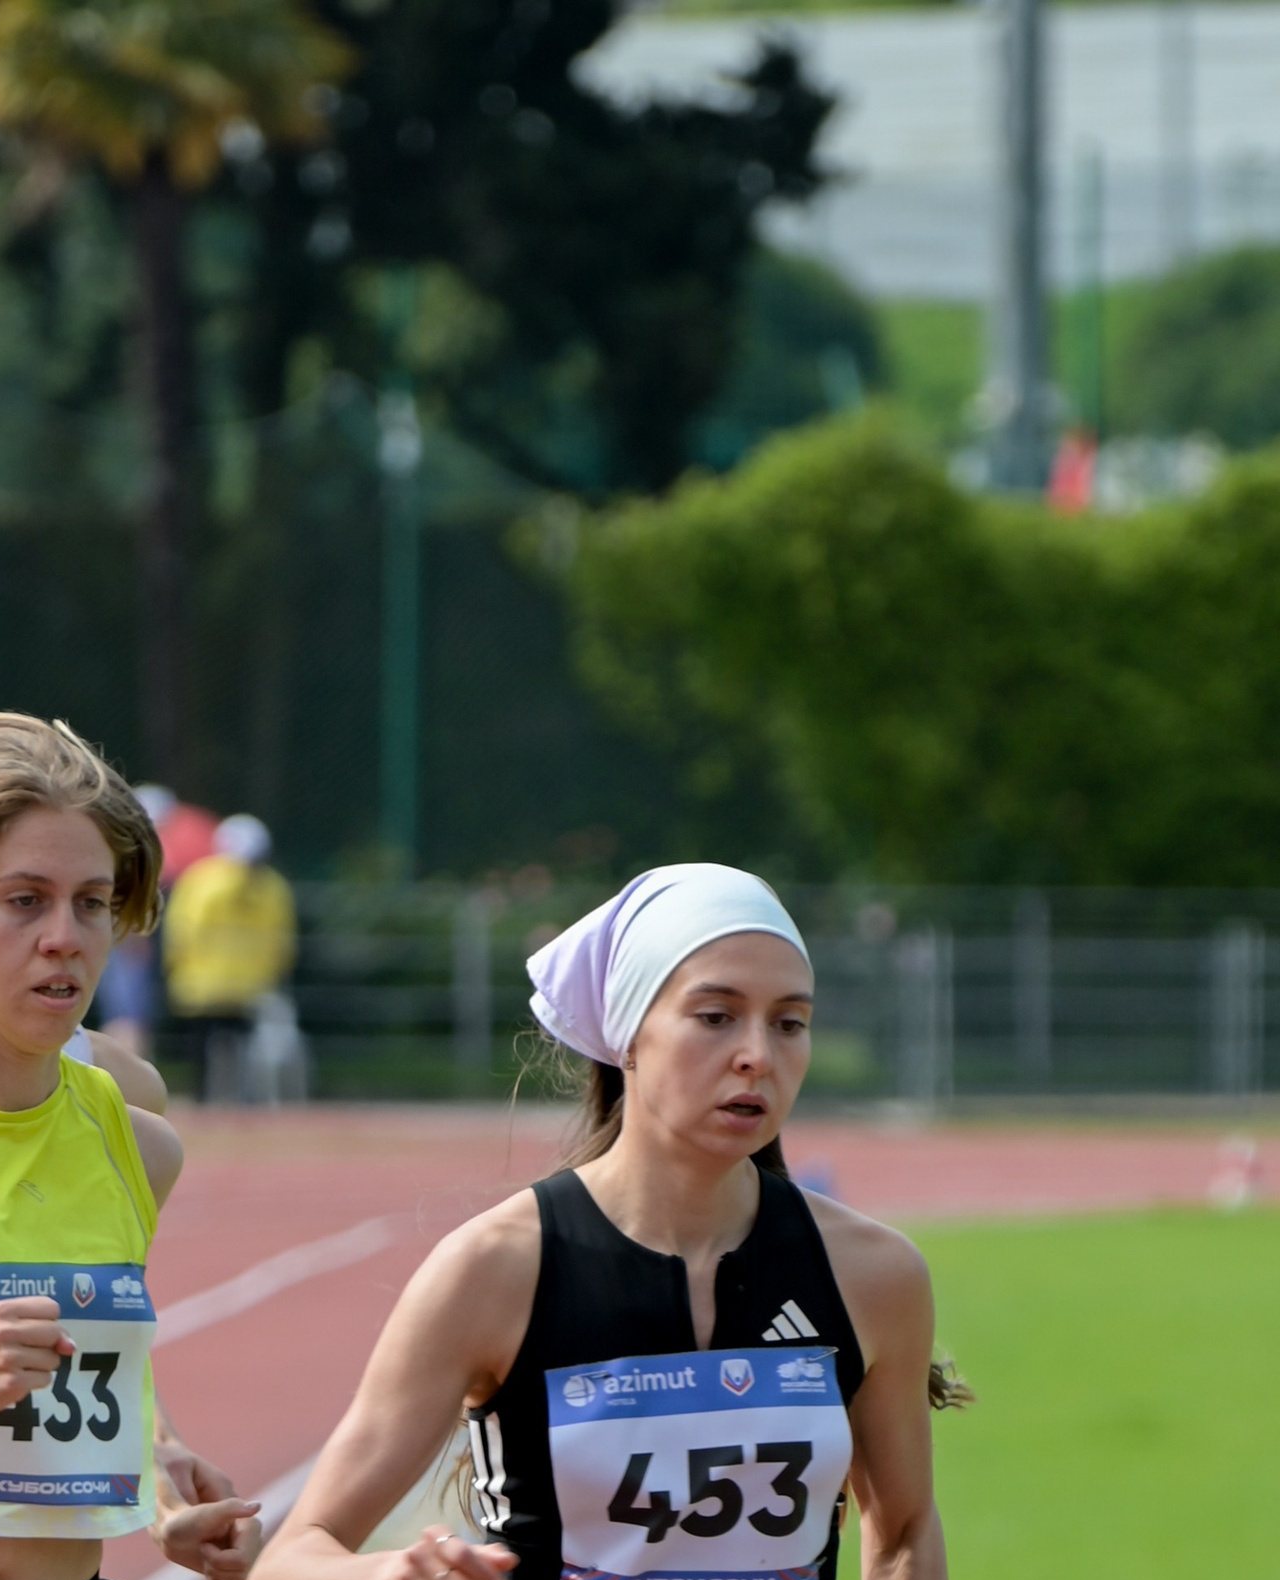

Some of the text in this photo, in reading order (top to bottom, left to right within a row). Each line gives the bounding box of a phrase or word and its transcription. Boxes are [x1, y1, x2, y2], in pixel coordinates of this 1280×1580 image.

[604, 1366, 696, 1394] azimut
[71, 1480, 110, 1494] СОЧИ
[607, 1441, 813, 1544] 453
